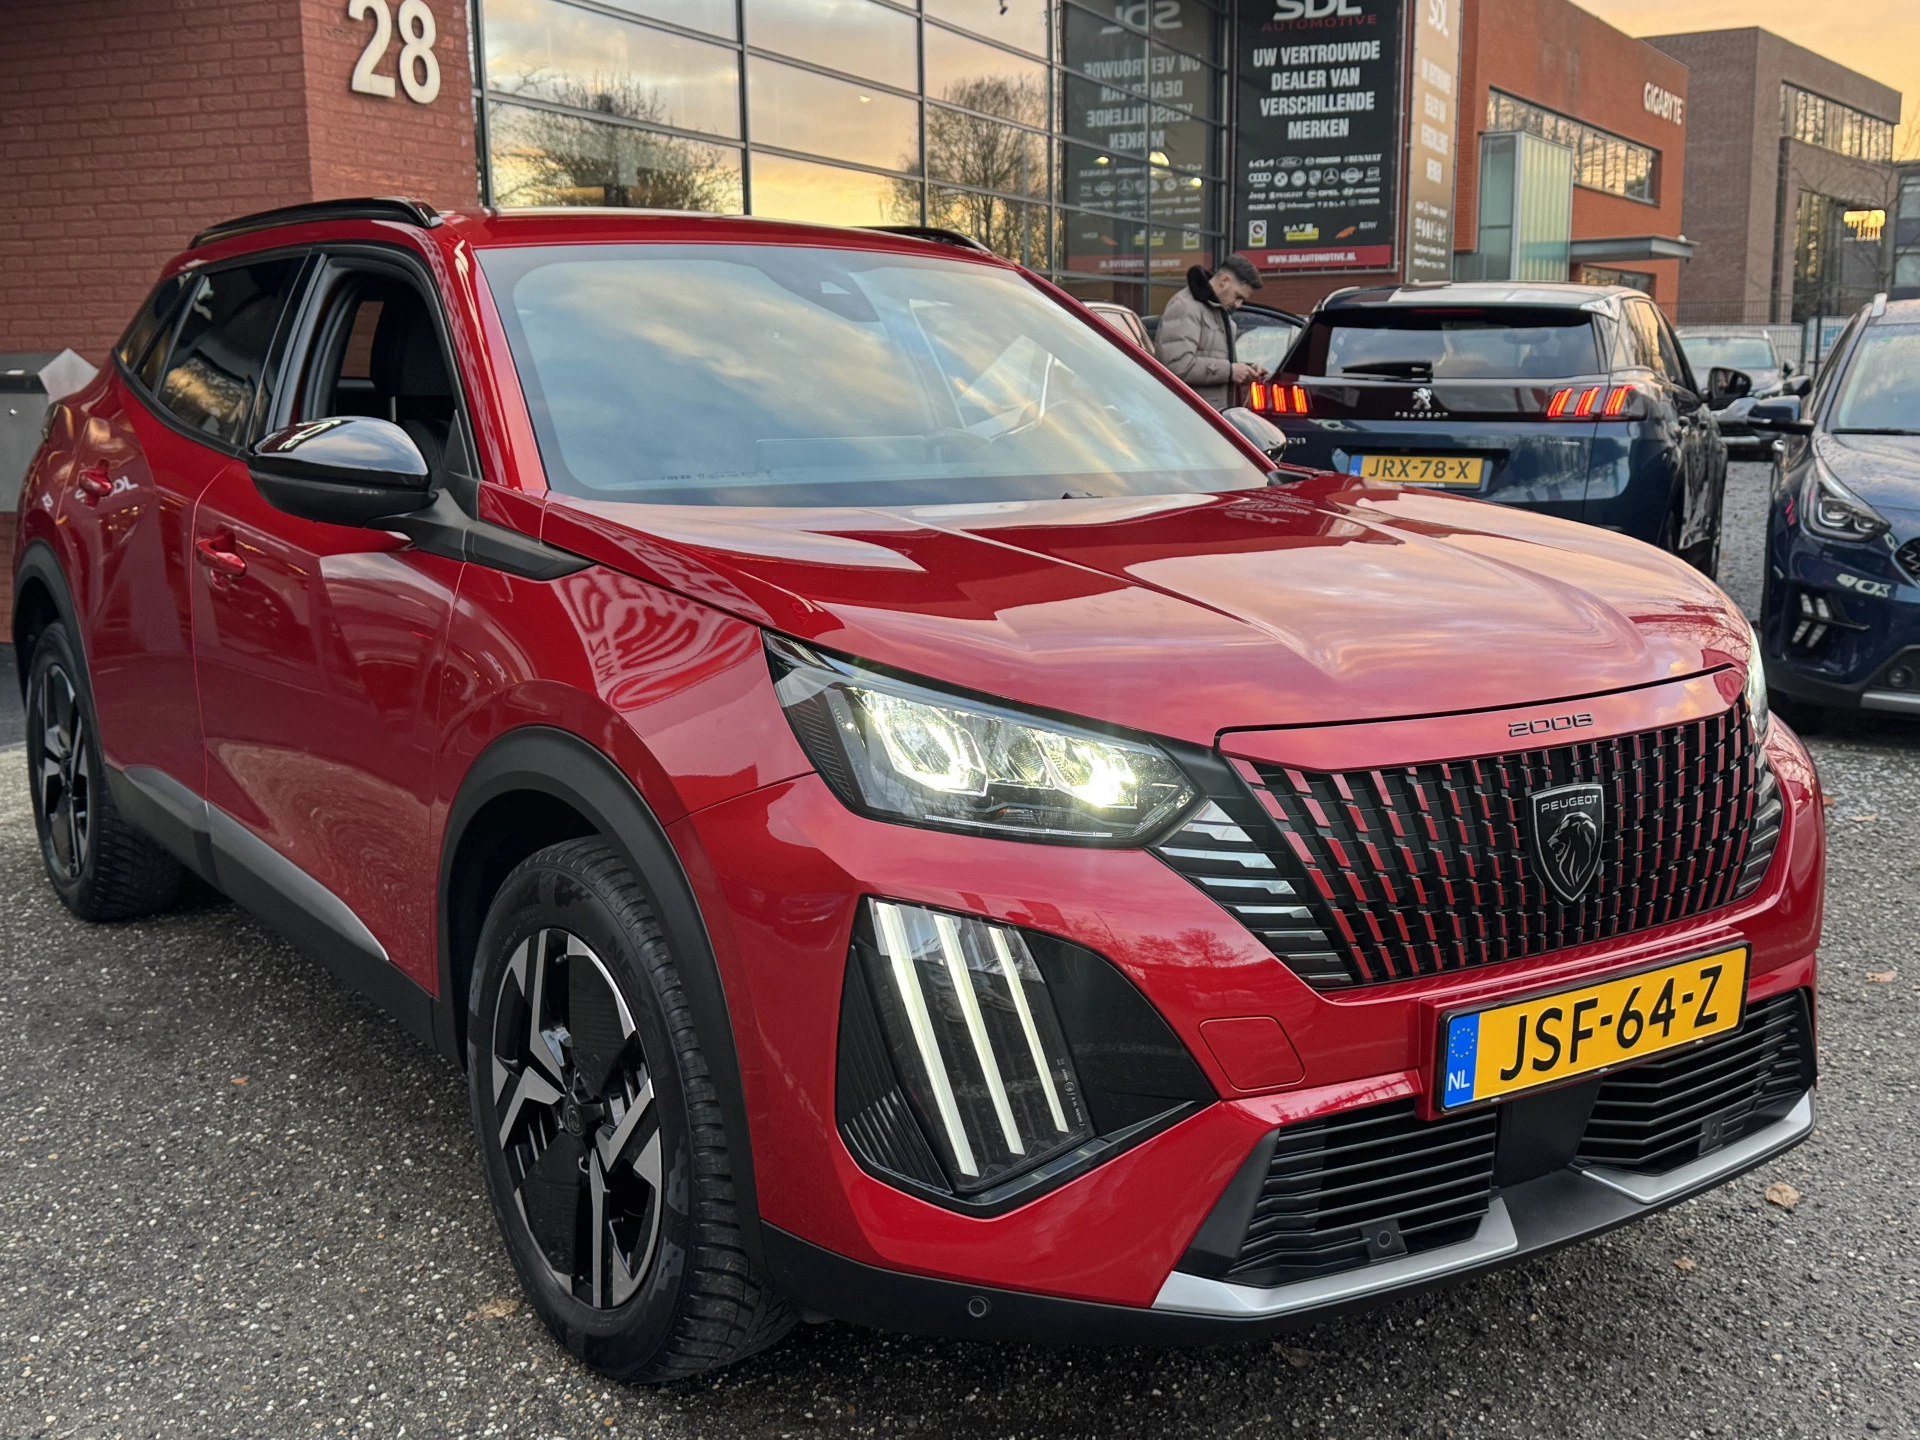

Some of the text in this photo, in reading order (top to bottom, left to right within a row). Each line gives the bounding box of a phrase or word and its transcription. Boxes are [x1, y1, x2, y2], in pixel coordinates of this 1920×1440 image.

[1261, 14, 1378, 32] AUTOMOTIVE
[348, 0, 441, 105] 28
[1253, 40, 1381, 67] UW VERTROUWDE
[1271, 67, 1361, 91] DEALER VAN
[1260, 91, 1376, 117] VERSCHILLENDE
[1643, 81, 1683, 126] GIGABYTE
[1287, 118, 1350, 140] MERKEN
[1368, 459, 1471, 480] JRX-78-X
[1508, 712, 1595, 738] 2008
[1541, 795, 1599, 813] PEUGEOT
[1447, 964, 1723, 1092] NL JSF-64-Z
